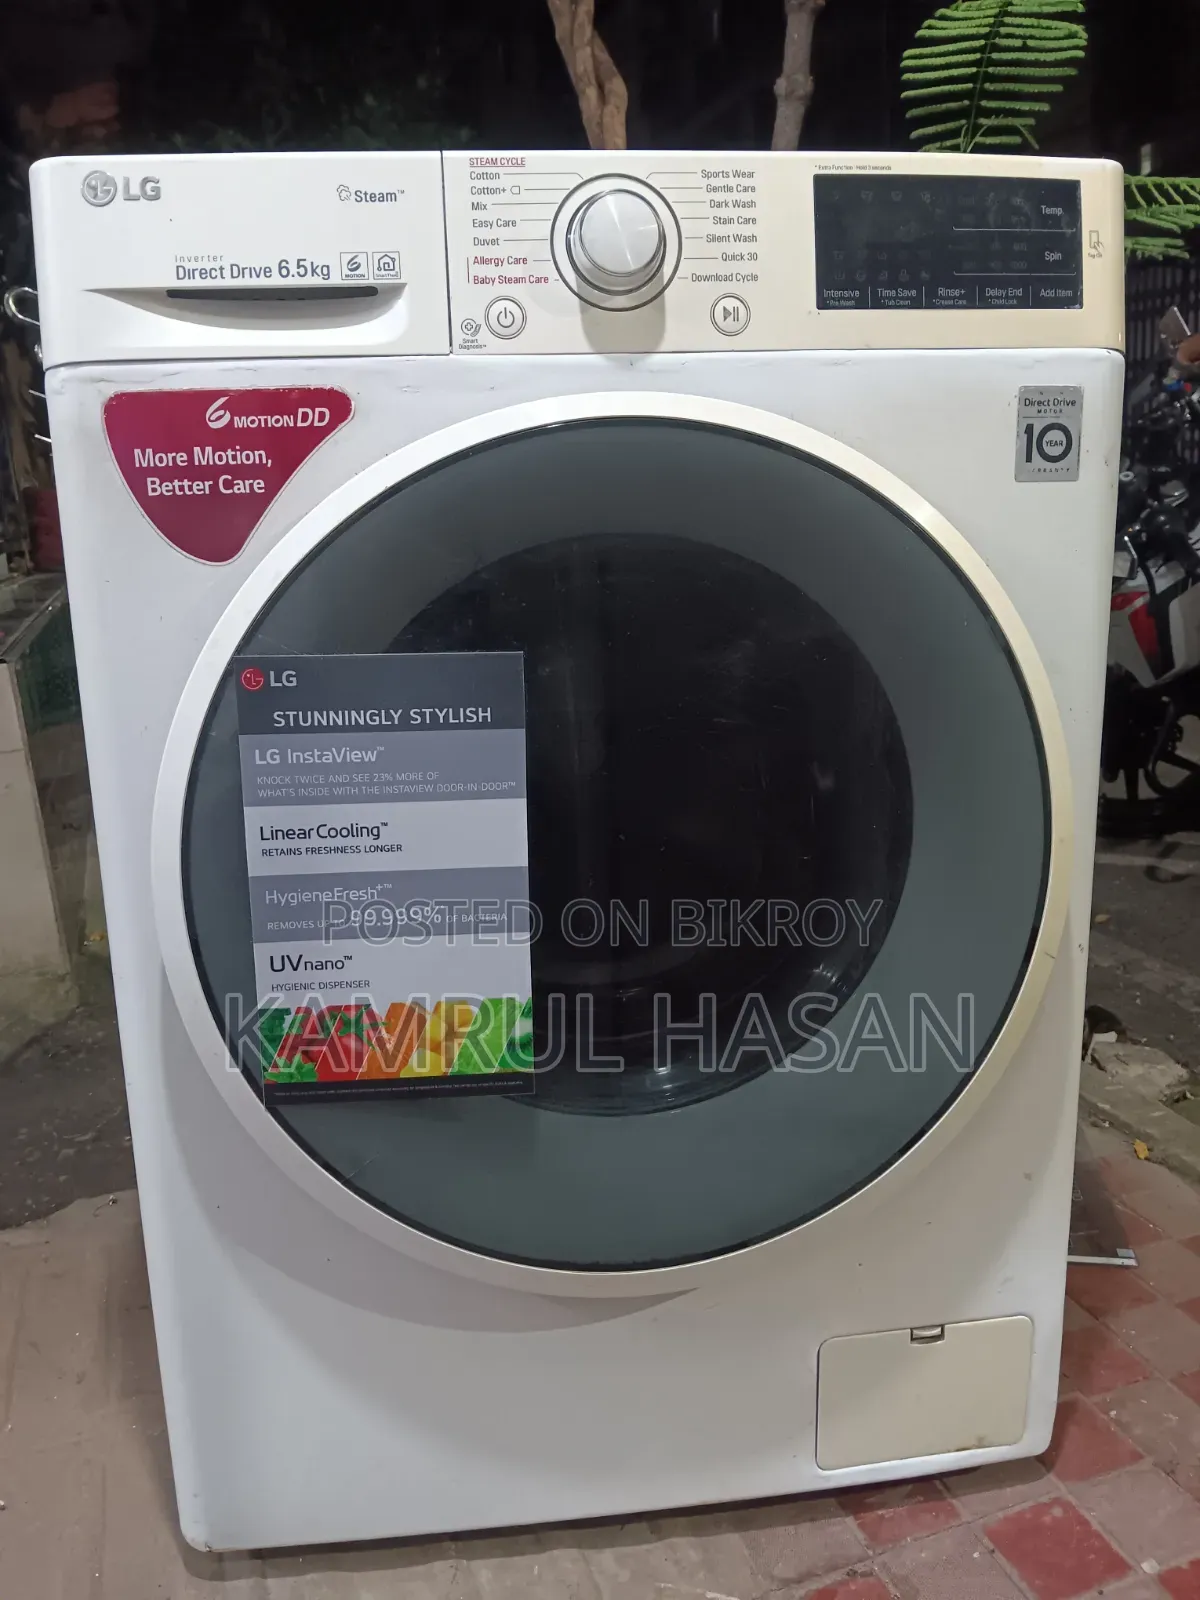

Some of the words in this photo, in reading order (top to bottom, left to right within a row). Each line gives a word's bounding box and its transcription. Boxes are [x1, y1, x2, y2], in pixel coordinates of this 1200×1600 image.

[469, 157, 498, 166] STEAM
[500, 157, 526, 166] CYCLE
[469, 171, 500, 180] Cotton
[701, 169, 730, 179] Sports
[732, 169, 755, 179] Wear
[122, 175, 162, 201] LG
[470, 186, 507, 195] Cotton+
[706, 184, 734, 193] Gentle
[736, 184, 756, 193] Care
[471, 202, 488, 211] Mix
[709, 199, 730, 208] Dark
[732, 199, 757, 208] Wash
[1041, 205, 1064, 216] Temp.
[472, 219, 495, 229] Easy
[496, 218, 517, 228] Care
[712, 216, 735, 225] Stain
[737, 216, 757, 225] Care
[473, 237, 500, 246] Duvet
[706, 233, 730, 243] Silent
[732, 233, 758, 243] Wash
[175, 254, 224, 263] Inverter
[473, 256, 505, 267] Allergy
[507, 255, 528, 265] Care
[721, 252, 746, 262] Quick
[747, 253, 758, 262] 30
[1044, 250, 1062, 262] Spin
[175, 264, 226, 281] Direct
[230, 264, 273, 279] Drive
[691, 272, 734, 282] Download
[735, 272, 759, 284] Cycle
[473, 275, 496, 286] Baby
[498, 274, 526, 284] Steam
[528, 274, 549, 284] Care
[823, 288, 860, 298] Intensive
[877, 288, 896, 297] Time
[897, 288, 917, 297] Save
[938, 287, 966, 296] Rinse+
[985, 287, 1006, 298] Delay
[1008, 287, 1023, 296] End
[1039, 288, 1055, 297] Add
[1056, 288, 1073, 297] Item
[1024, 397, 1050, 407] Direct
[1053, 397, 1076, 407] Drive
[234, 415, 294, 428] MOTION
[296, 407, 330, 427] DD
[1024, 422, 1073, 463] 10
[1045, 439, 1063, 447] YEAR
[133, 448, 188, 468] More
[193, 445, 272, 467] Motion,
[146, 477, 213, 496] Better
[218, 475, 265, 494] Care
[269, 670, 297, 687] LG
[273, 709, 403, 728] STUNNINGLY
[410, 707, 492, 724] STYLISH
[255, 749, 281, 765] LG
[257, 775, 291, 785] KNOCK
[294, 775, 326, 784] TWICE
[328, 774, 349, 783] AND
[352, 773, 370, 783] SEE
[373, 773, 393, 782] 23%
[396, 772, 424, 781] MORE
[427, 772, 439, 781] OF
[257, 788, 296, 797] WHAT'S
[298, 787, 330, 796] INSIDE
[332, 786, 359, 796] WITH
[361, 785, 380, 795] THE
[382, 784, 434, 794] INSTAVIEW
[261, 847, 303, 857] RETAINS
[305, 845, 361, 856] FRESHNESS
[364, 844, 403, 854] LONGER
[267, 921, 315, 930] REMOVES
[446, 914, 459, 923] OF
[461, 912, 508, 923] BACTERIA
[271, 981, 316, 992] HYGIENIC
[318, 979, 371, 990] DISPENSER
